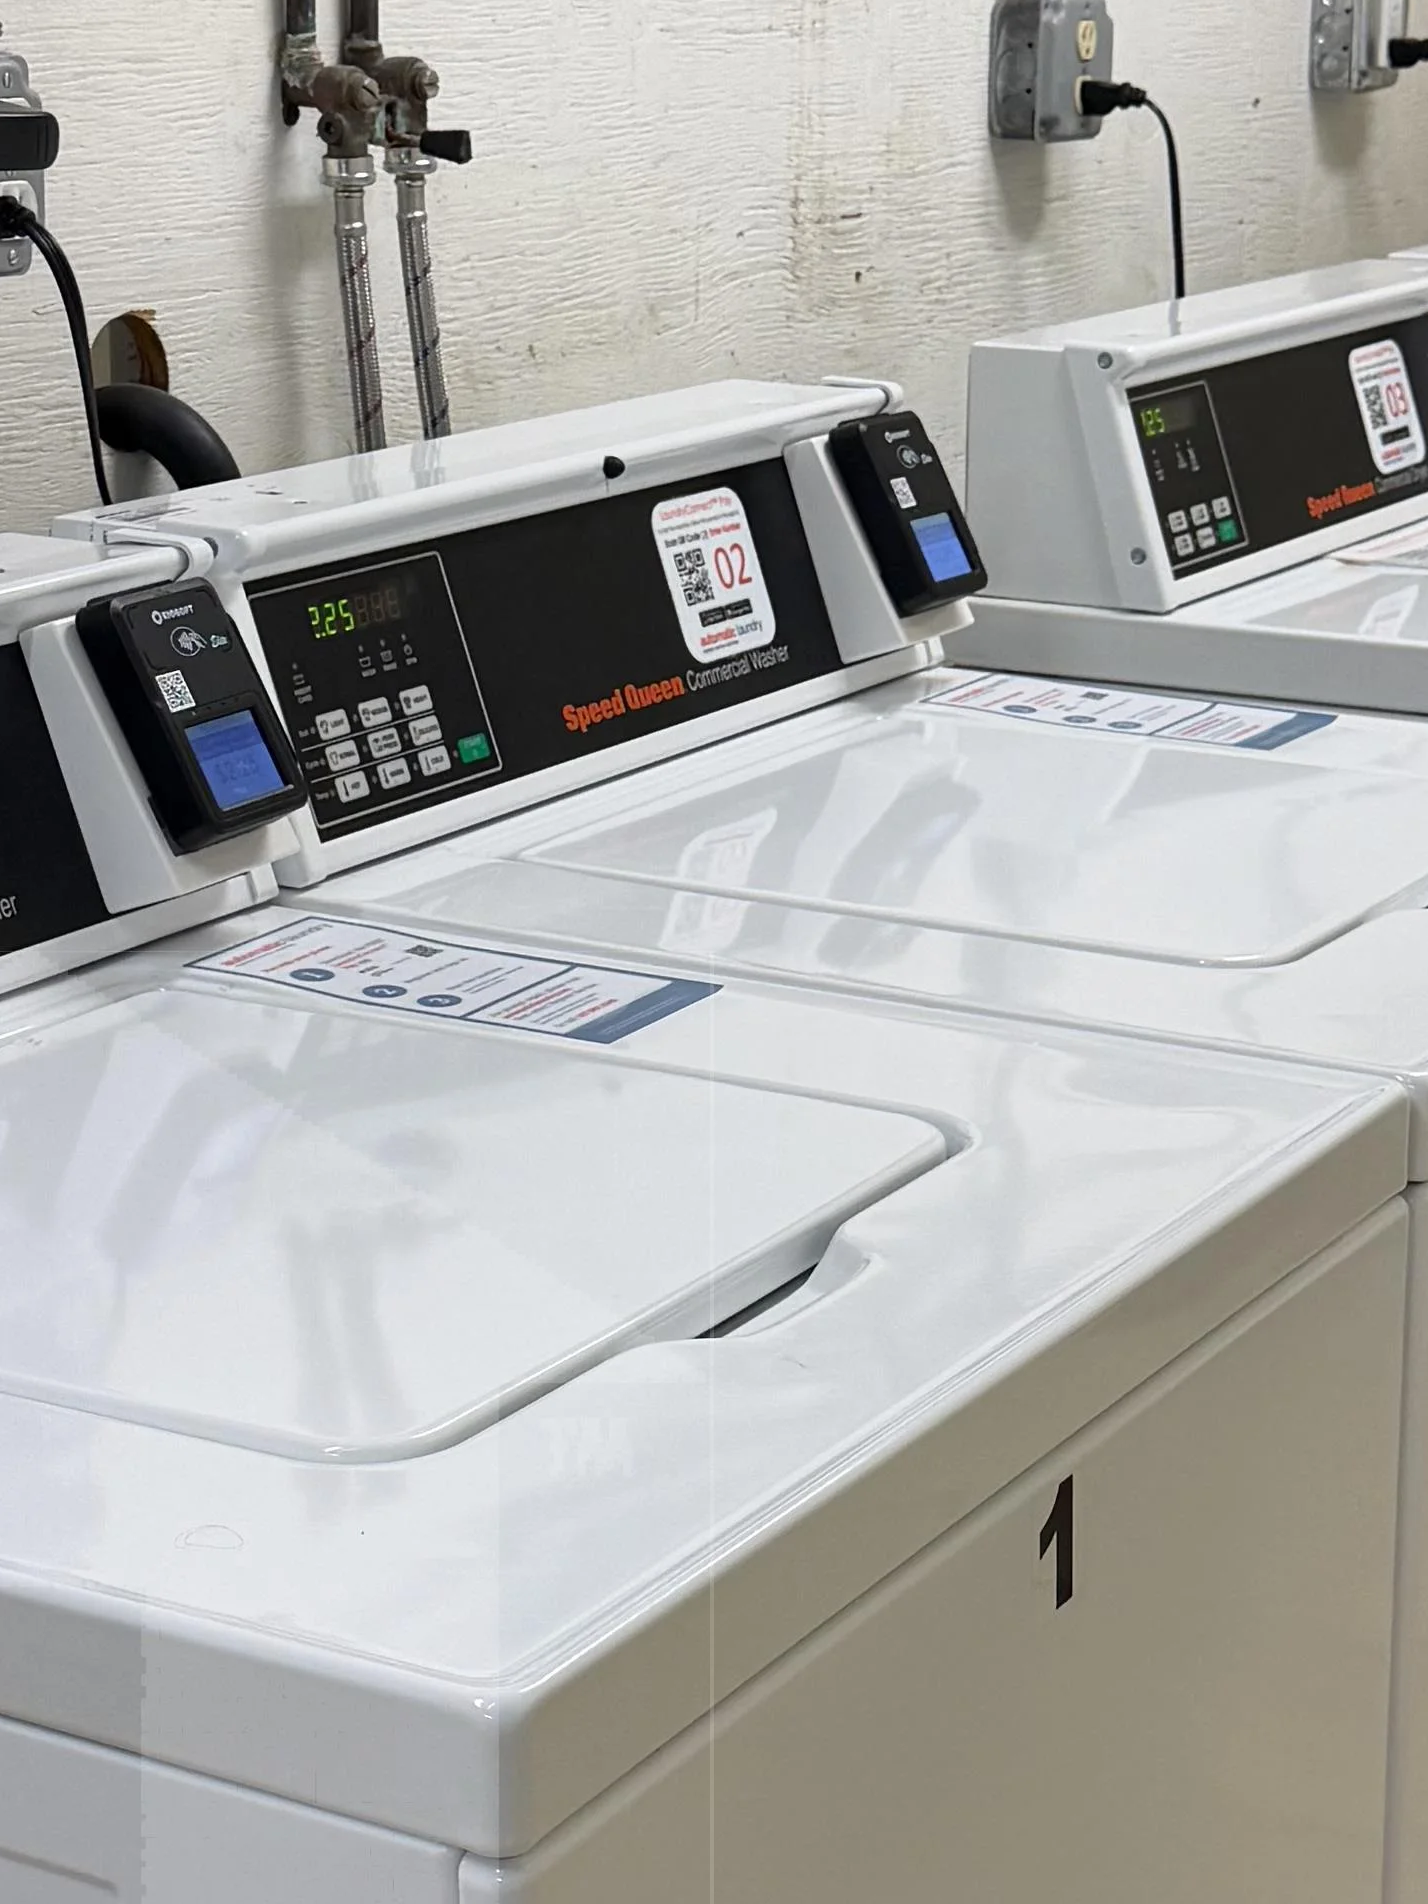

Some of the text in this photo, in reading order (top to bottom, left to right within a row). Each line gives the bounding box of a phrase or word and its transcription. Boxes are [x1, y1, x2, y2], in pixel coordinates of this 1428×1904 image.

[1384, 381, 1410, 418] 03
[713, 542, 753, 590] 02
[562, 644, 790, 734] Speed Queen Commercial Washer
[1039, 1473, 1073, 1610] 1
